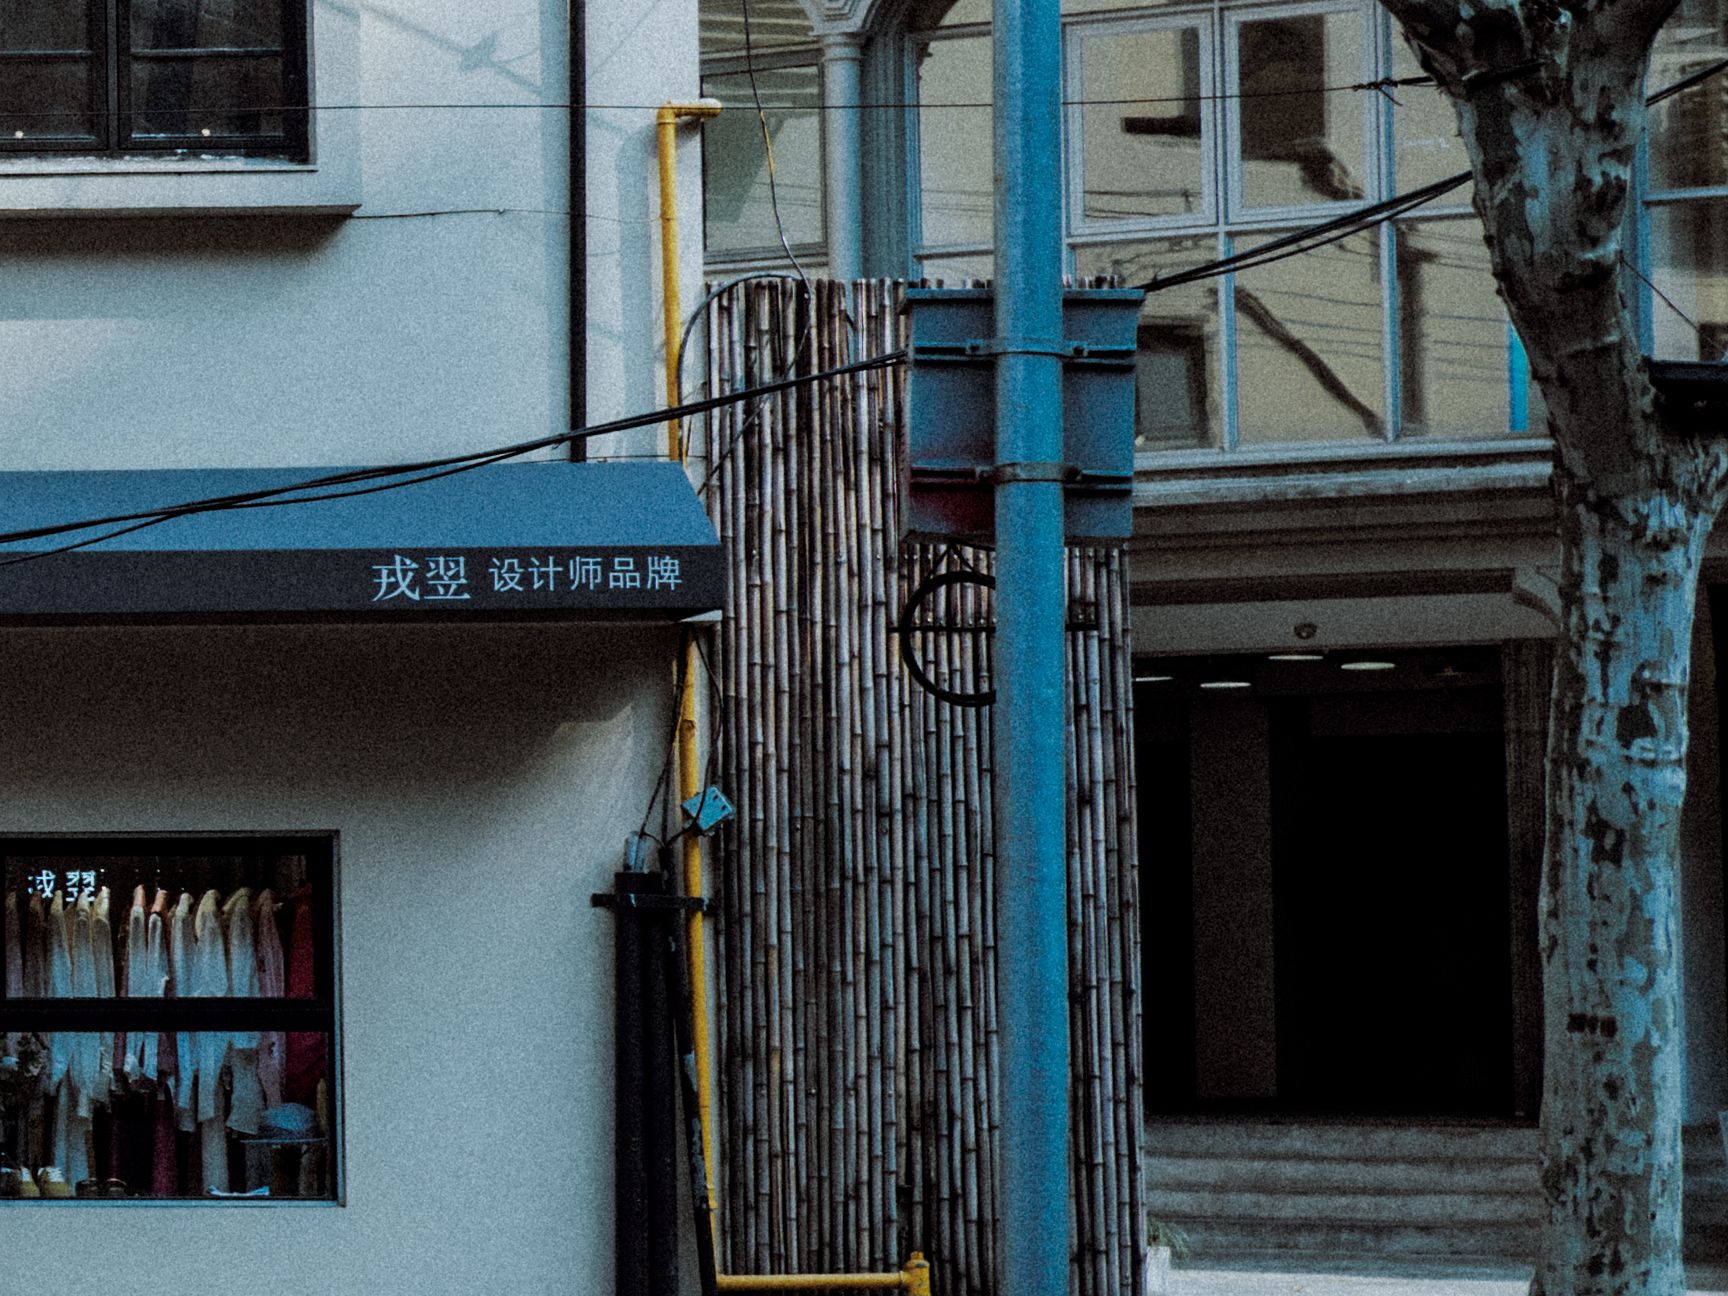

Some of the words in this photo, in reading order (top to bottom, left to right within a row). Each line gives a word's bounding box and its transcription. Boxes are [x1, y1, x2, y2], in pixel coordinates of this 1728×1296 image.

[371, 554, 471, 601] 戎翌
[488, 555, 682, 592] 设计师品牌
